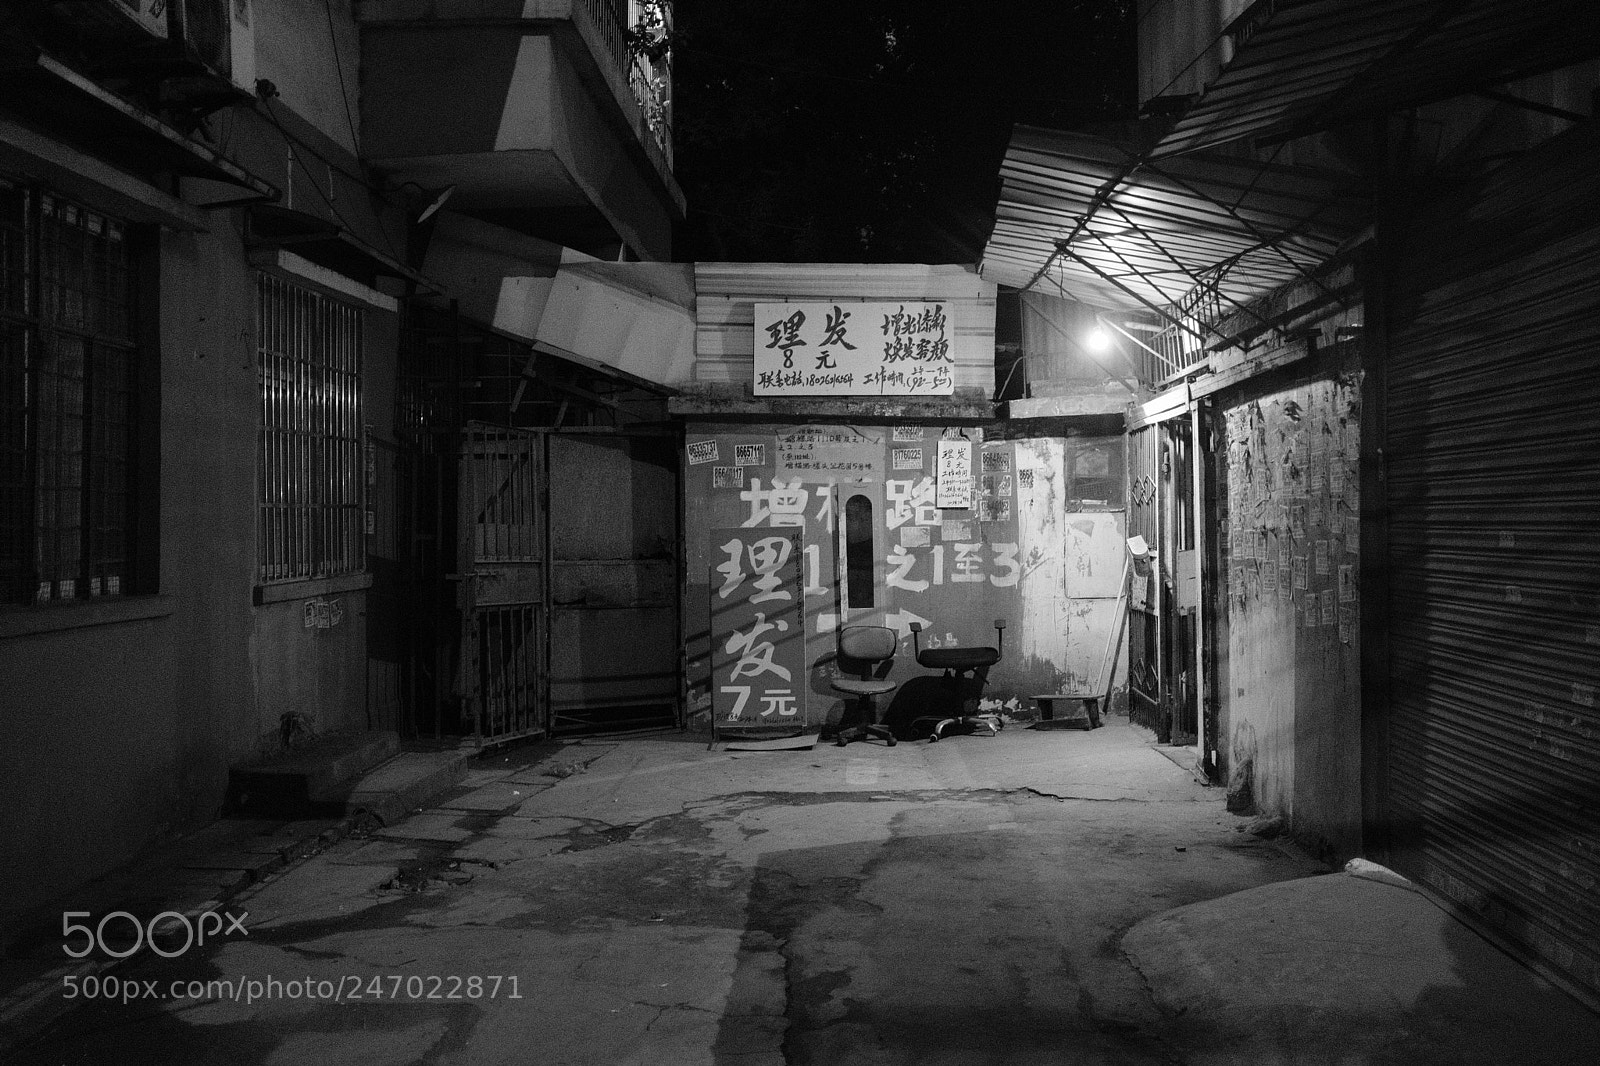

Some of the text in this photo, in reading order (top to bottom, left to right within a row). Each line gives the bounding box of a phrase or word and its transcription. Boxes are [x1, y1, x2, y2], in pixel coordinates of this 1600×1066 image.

[765, 305, 858, 350] 理发
[880, 304, 947, 341] 增光添彩
[783, 349, 837, 369] 8元
[882, 336, 955, 363] 焕发容颜
[941, 447, 970, 460] 理发
[717, 535, 792, 682] 理发
[720, 685, 797, 722] 7元
